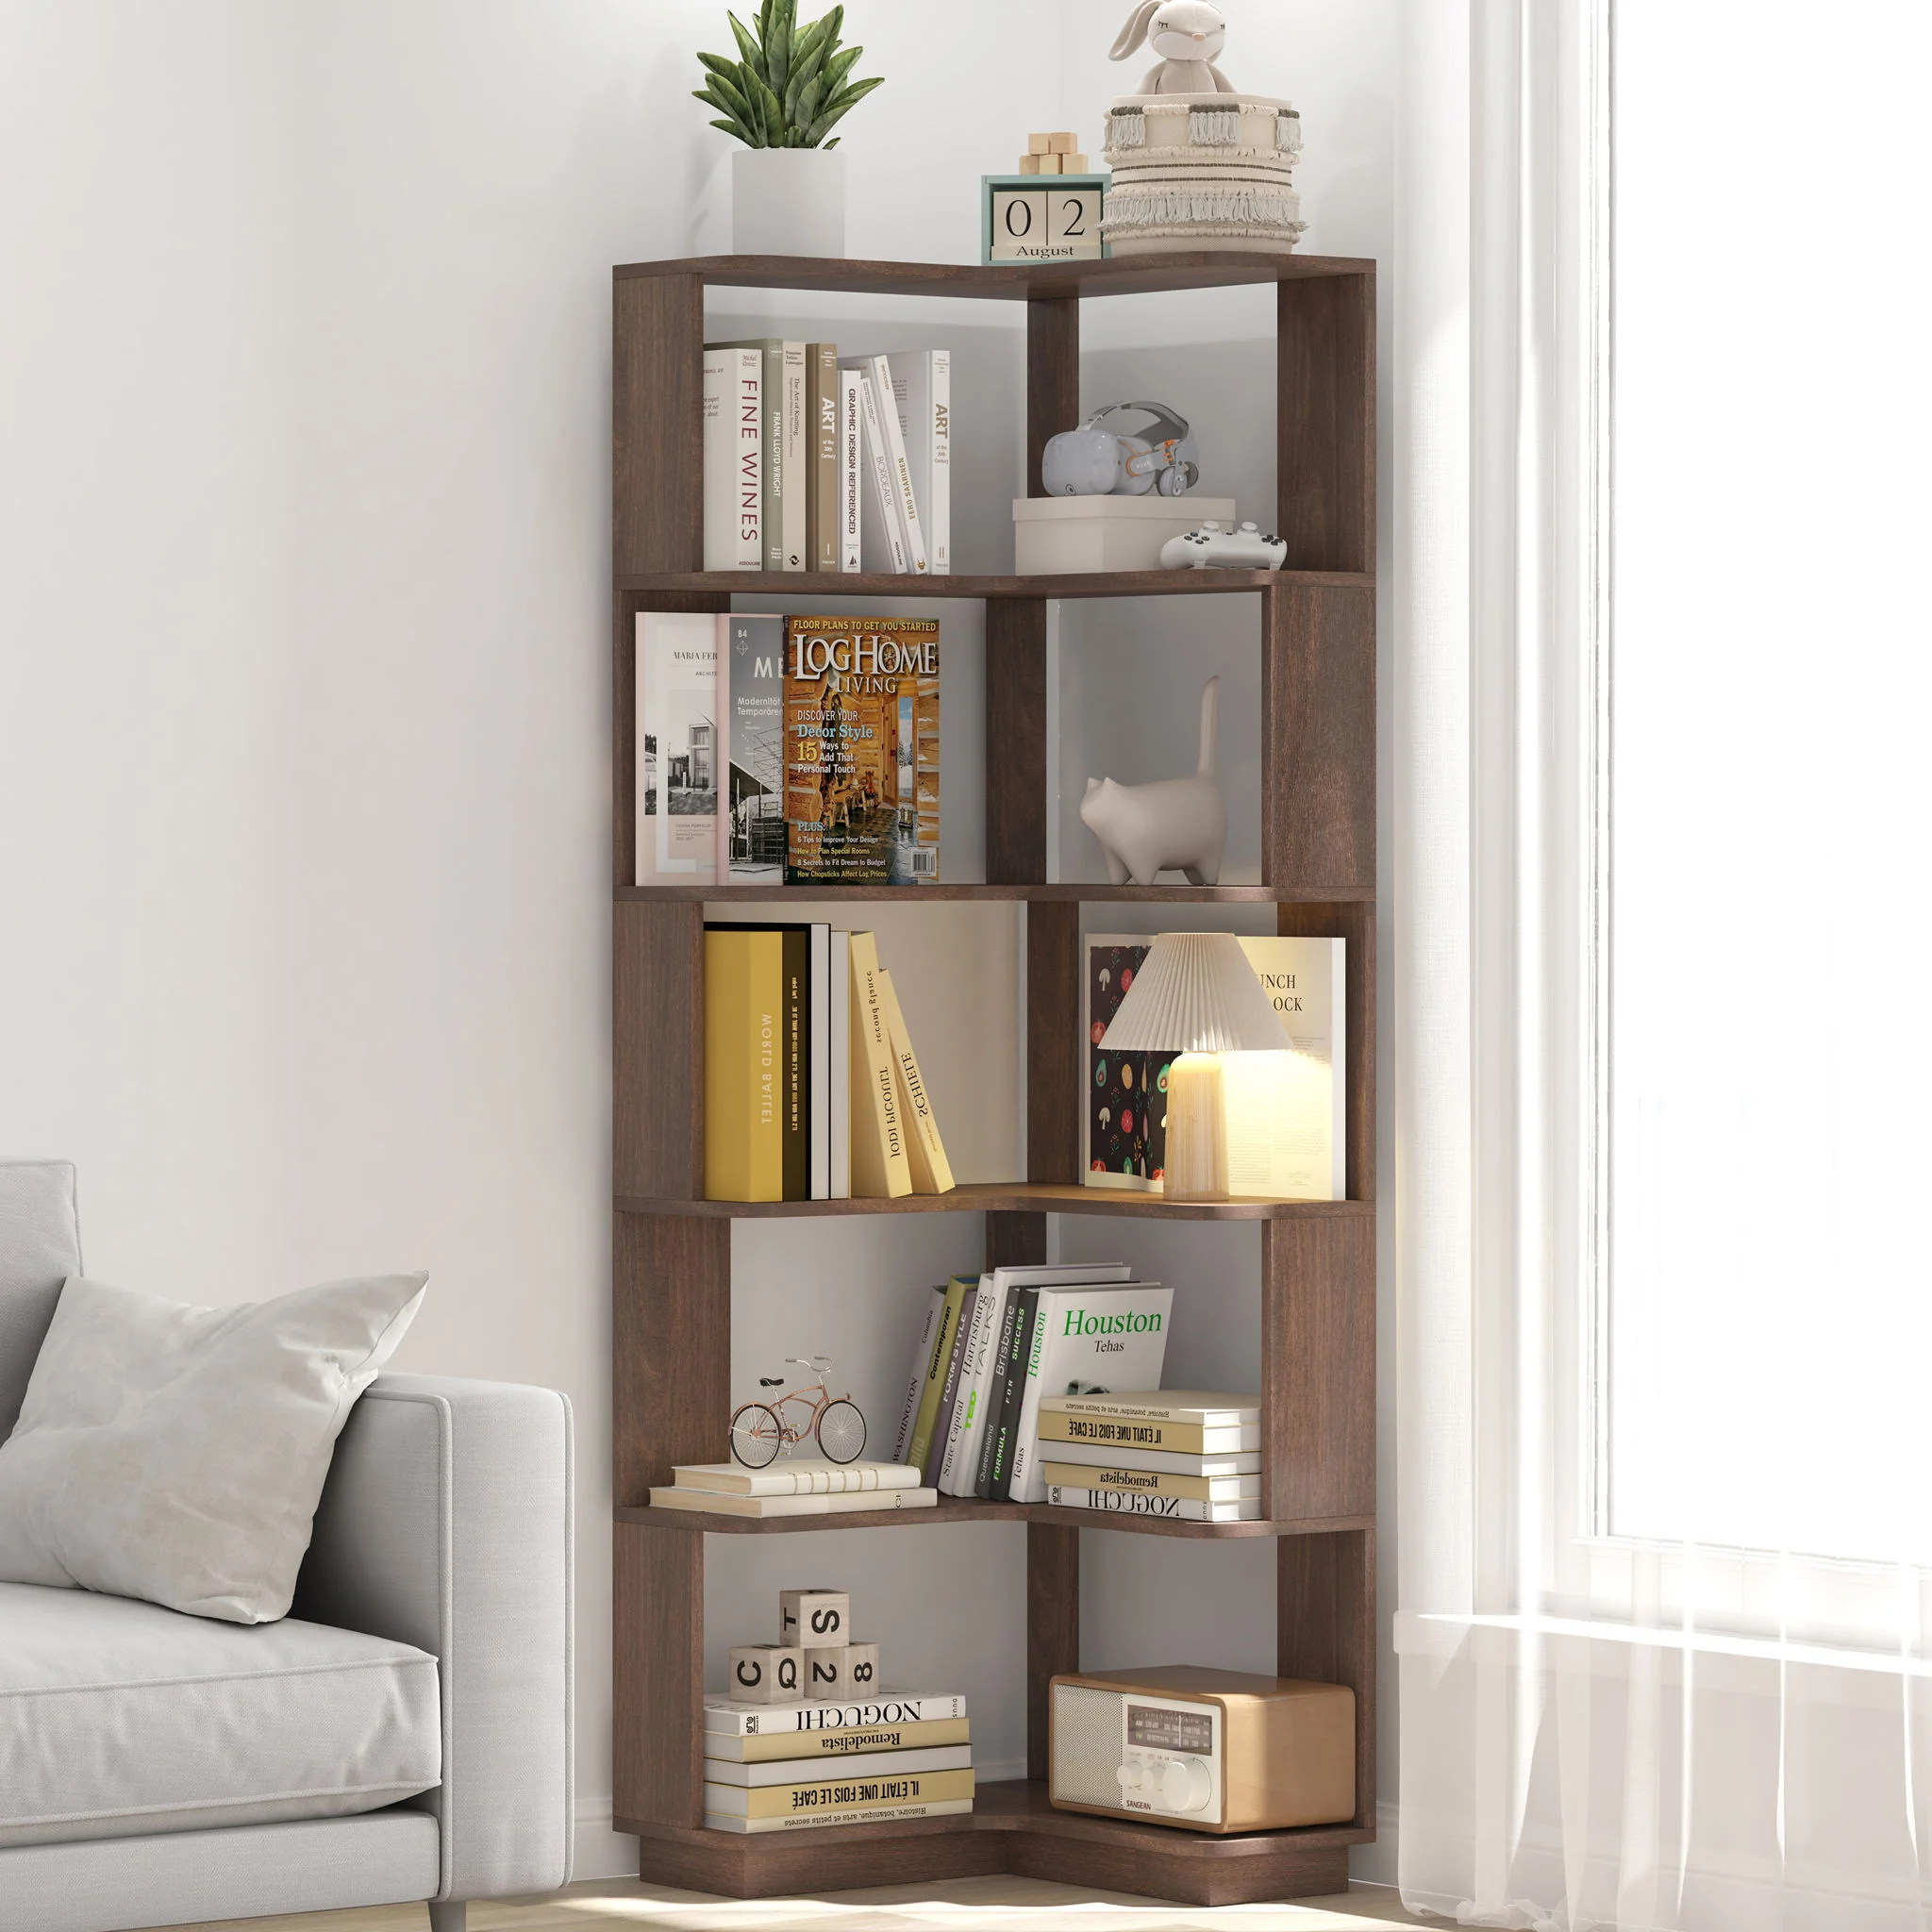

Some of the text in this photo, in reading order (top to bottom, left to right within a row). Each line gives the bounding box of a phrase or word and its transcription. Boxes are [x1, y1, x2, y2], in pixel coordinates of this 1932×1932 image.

[1006, 199, 1032, 237] 0
[1062, 199, 1086, 236] 2
[1016, 245, 1074, 259] August
[741, 380, 758, 439] FINE
[822, 397, 836, 434] ART
[935, 404, 948, 440] ART
[792, 410, 801, 436] Knitting
[773, 411, 781, 497] FRANK LLOYD WRIGHT
[877, 456, 893, 508] BORDEAUX
[898, 458, 916, 520] EERO SAARINEN
[741, 452, 758, 541] WINES
[737, 629, 748, 638] 84
[793, 619, 821, 629] FLOOR
[822, 619, 849, 630] PLANS
[851, 621, 862, 630] TO
[864, 621, 879, 631] GET
[882, 622, 899, 631] YOU
[901, 622, 937, 632] STARTED
[674, 651, 700, 660] MARIA
[837, 676, 897, 694] LIVING
[797, 710, 858, 721] DISCOVER YOUR
[797, 724, 874, 741] Decor Style
[797, 741, 849, 761] 15 Ways to
[820, 753, 854, 762] Add That
[798, 764, 856, 774] Personal Touch
[798, 822, 830, 832] PLUS:
[803, 836, 815, 844] Tips
[823, 836, 845, 844] Improve
[860, 836, 878, 844] Design
[810, 871, 840, 879] Chopsticks
[866, 859, 886, 867] Budget
[963, 1292, 989, 1375] Harrisburg
[1062, 1308, 1162, 1337] Houston
[996, 1305, 1015, 1376] Brisbane
[1028, 1312, 1046, 1377] Houston
[1094, 1340, 1125, 1353] Tehas
[943, 1313, 966, 1403] FORM STYLE
[993, 1307, 1025, 1481] FORMULA FOR SUCCESS
[892, 1376, 918, 1461] WASHINGTON
[943, 1399, 964, 1477] State Capital
[979, 1424, 994, 1482] Queensland
[1014, 1446, 1025, 1479] Tehas
[783, 1607, 797, 1631] T
[811, 1609, 840, 1634] S
[737, 1660, 762, 1687] C
[778, 1657, 797, 1690] Q
[812, 1661, 837, 1683] 2
[853, 1662, 873, 1682] 8
[796, 1701, 922, 1731] NOGUCHI
[821, 1732, 901, 1751] Remodelista
[791, 1781, 920, 1810] IL ÉTAIT UNE FOIS LE CAFÉ
[784, 1818, 810, 1827] secrets
[811, 1815, 833, 1824] petits
[859, 1810, 895, 1820] botanique,
[896, 1807, 926, 1816] Histoire,
